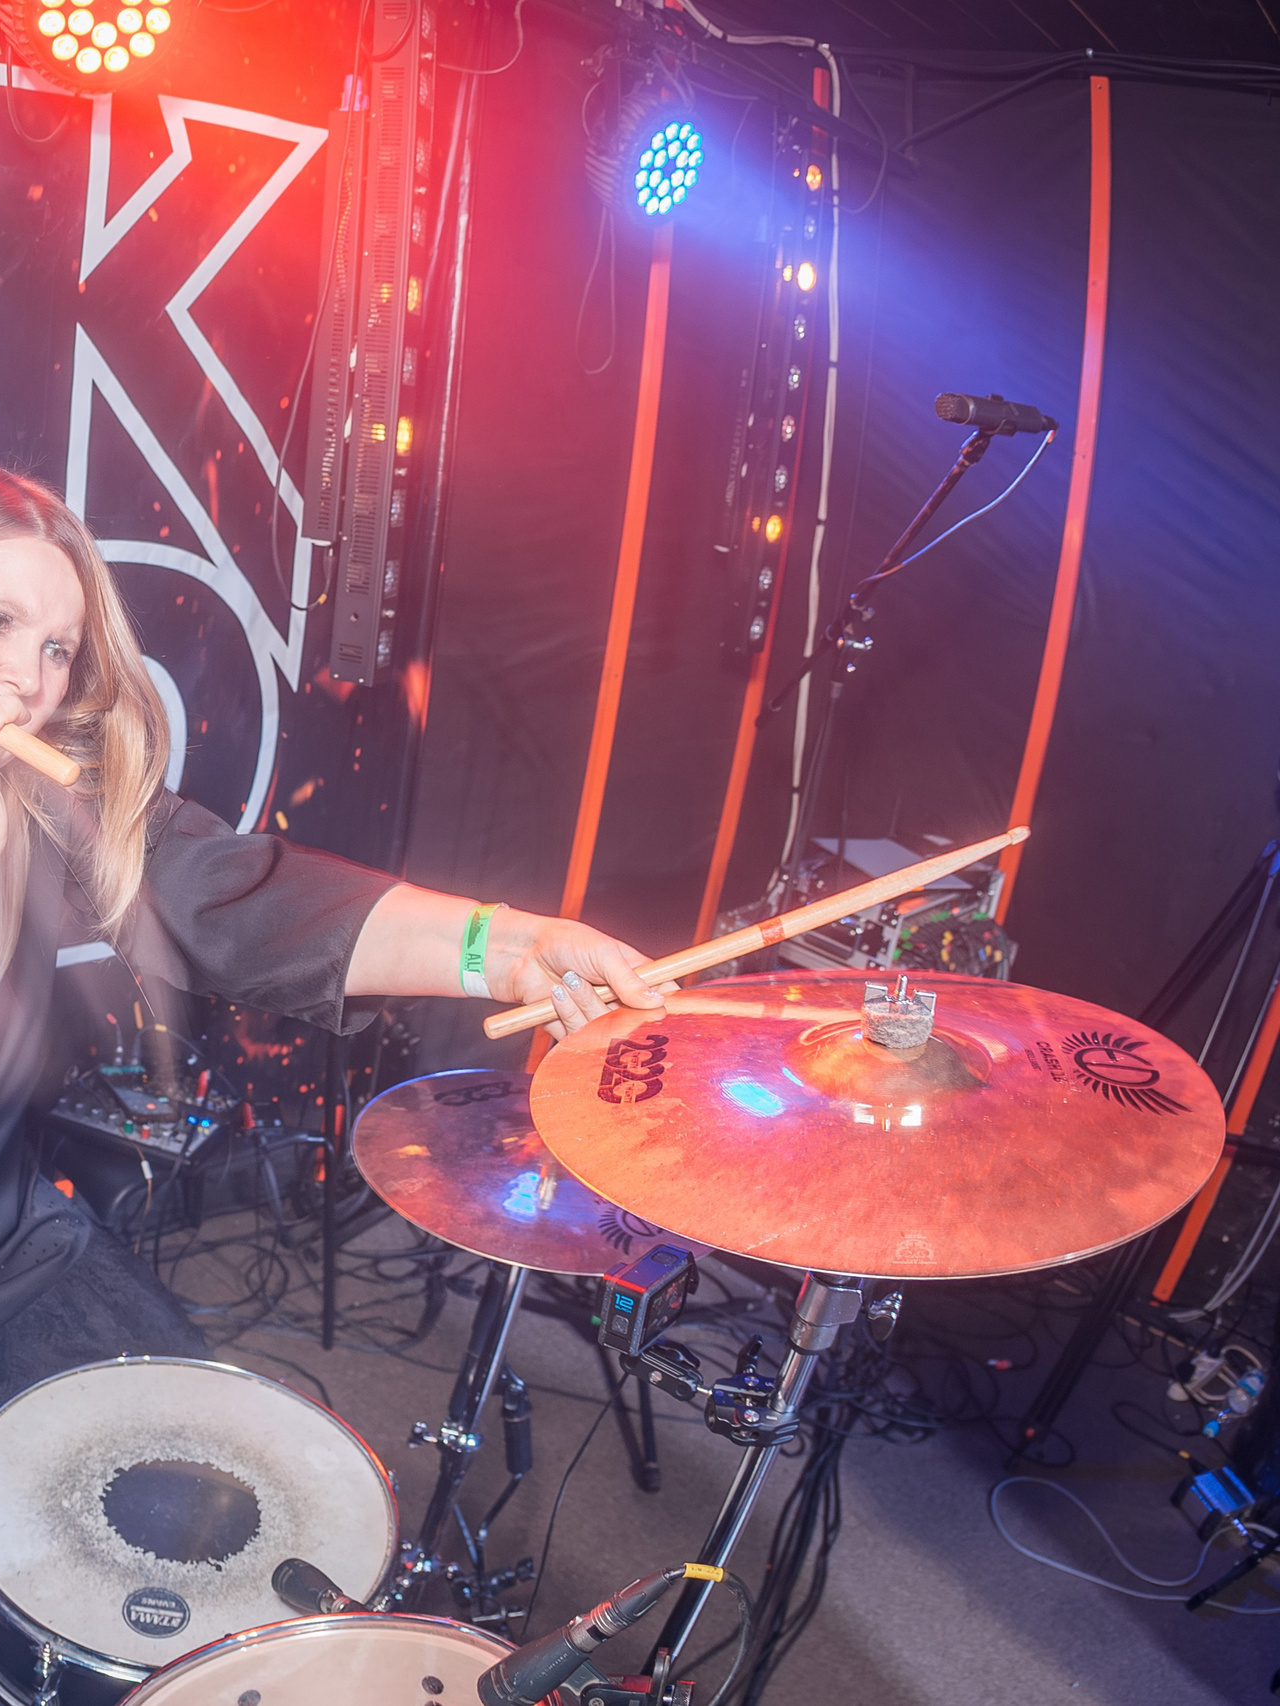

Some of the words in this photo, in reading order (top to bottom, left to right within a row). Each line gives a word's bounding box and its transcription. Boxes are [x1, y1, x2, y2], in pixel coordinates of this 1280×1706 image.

[1036, 1042, 1063, 1070] CRASH
[615, 1293, 634, 1310] 12
[130, 1610, 171, 1627] TAMA
